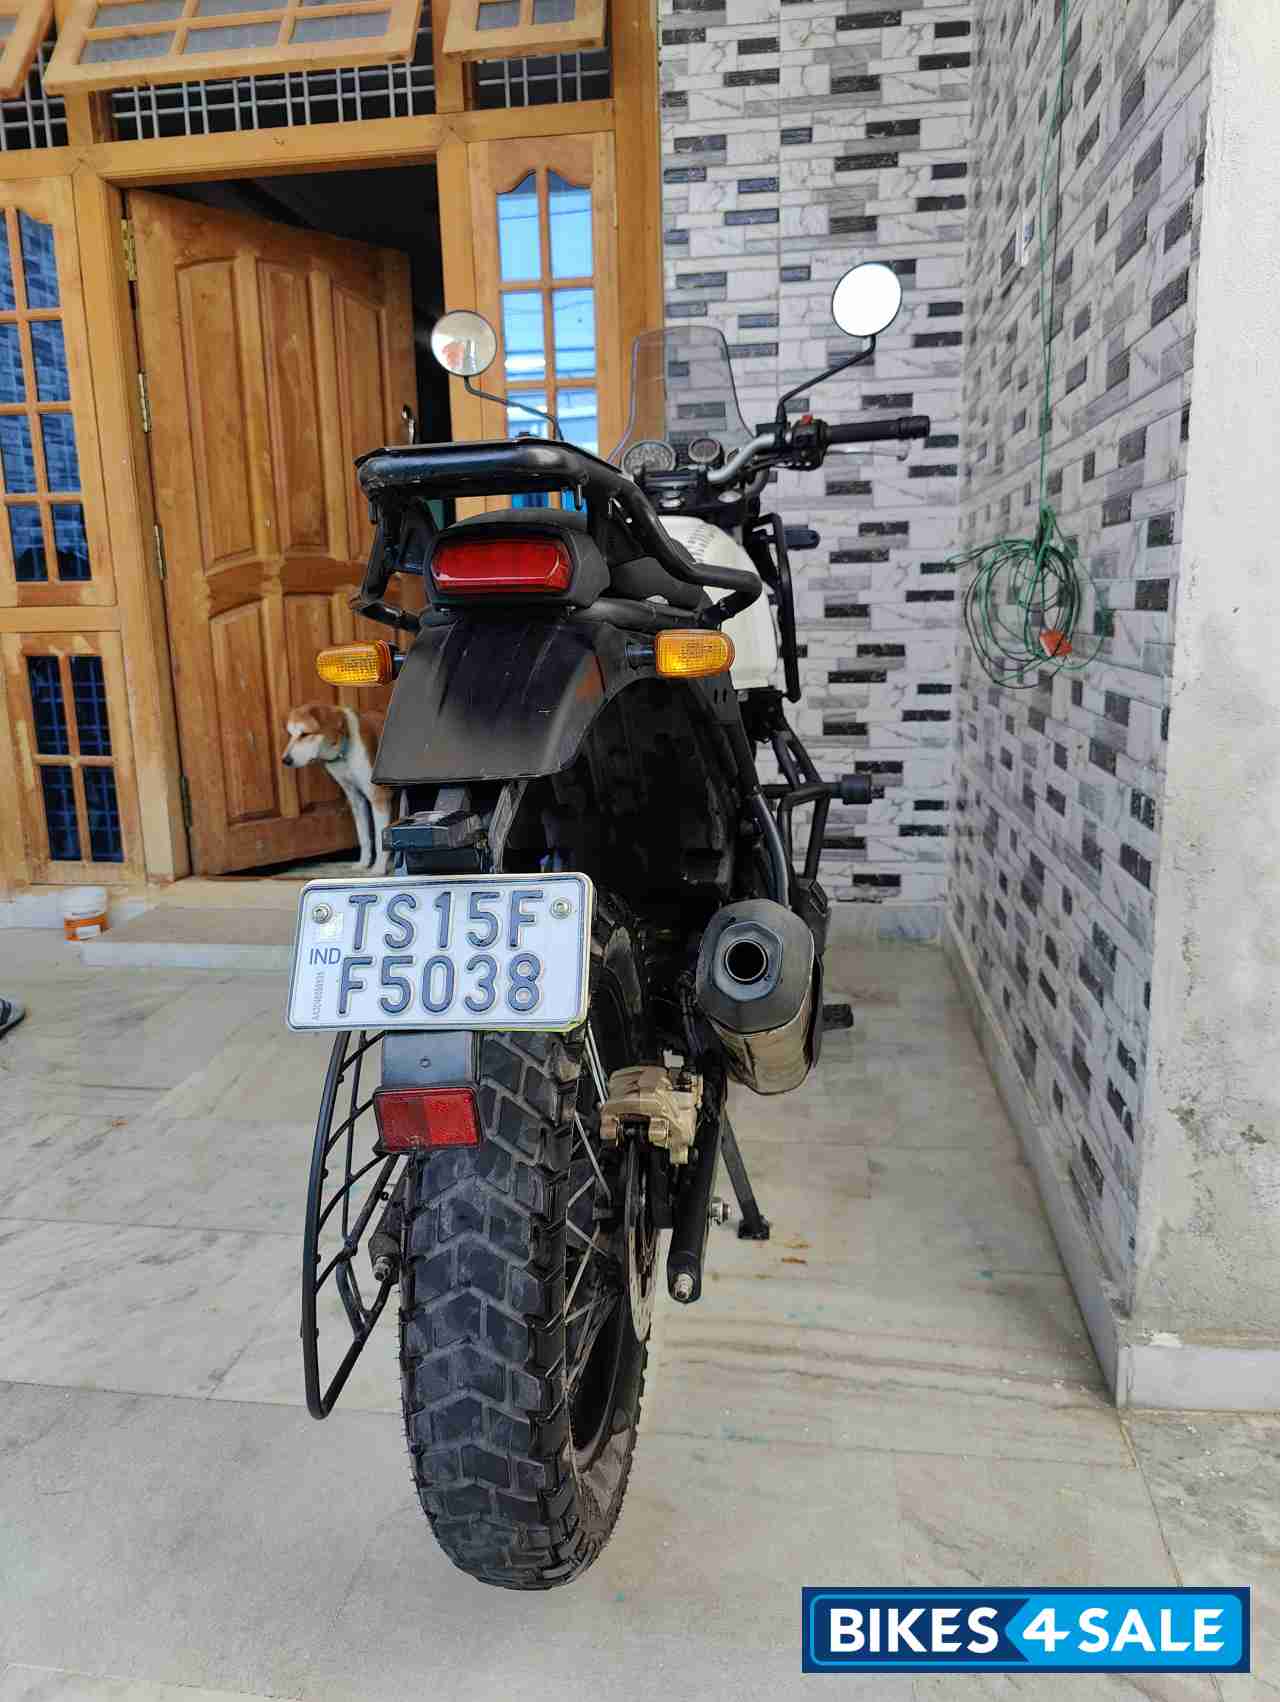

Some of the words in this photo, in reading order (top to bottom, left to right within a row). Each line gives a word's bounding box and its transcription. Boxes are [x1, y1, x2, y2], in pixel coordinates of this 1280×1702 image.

[348, 889, 544, 951] TS15F
[309, 947, 341, 965] IND
[338, 953, 542, 1015] F5038
